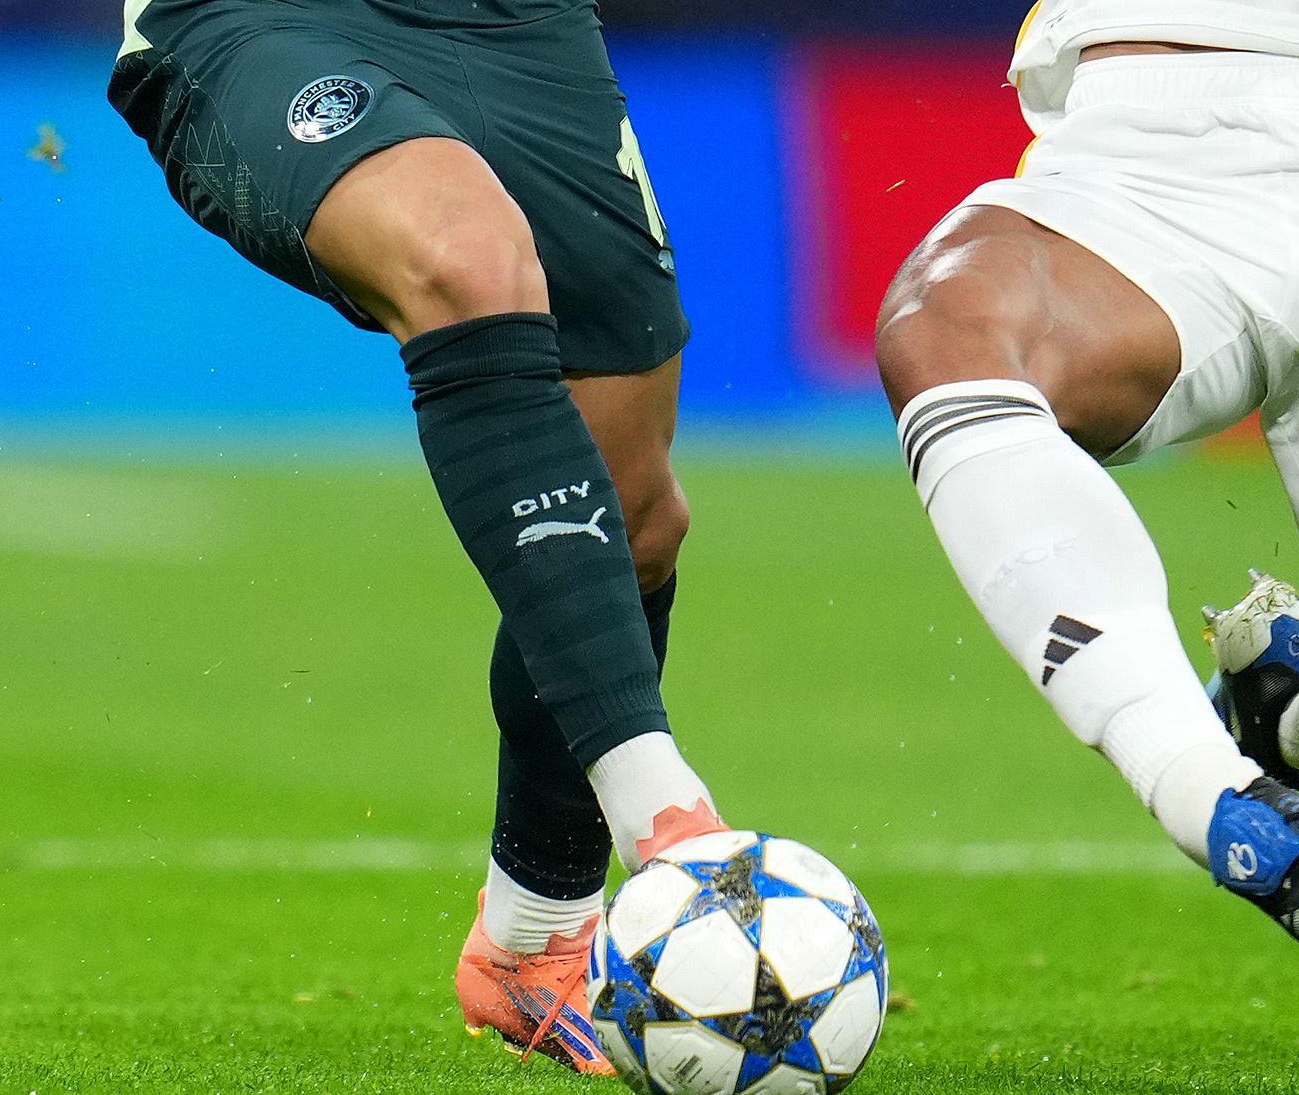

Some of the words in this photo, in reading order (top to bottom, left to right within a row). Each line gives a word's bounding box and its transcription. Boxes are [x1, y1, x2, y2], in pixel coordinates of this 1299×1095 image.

[293, 79, 356, 122] MANCHESTER
[332, 112, 356, 132] CITY
[511, 479, 591, 518] CITY
